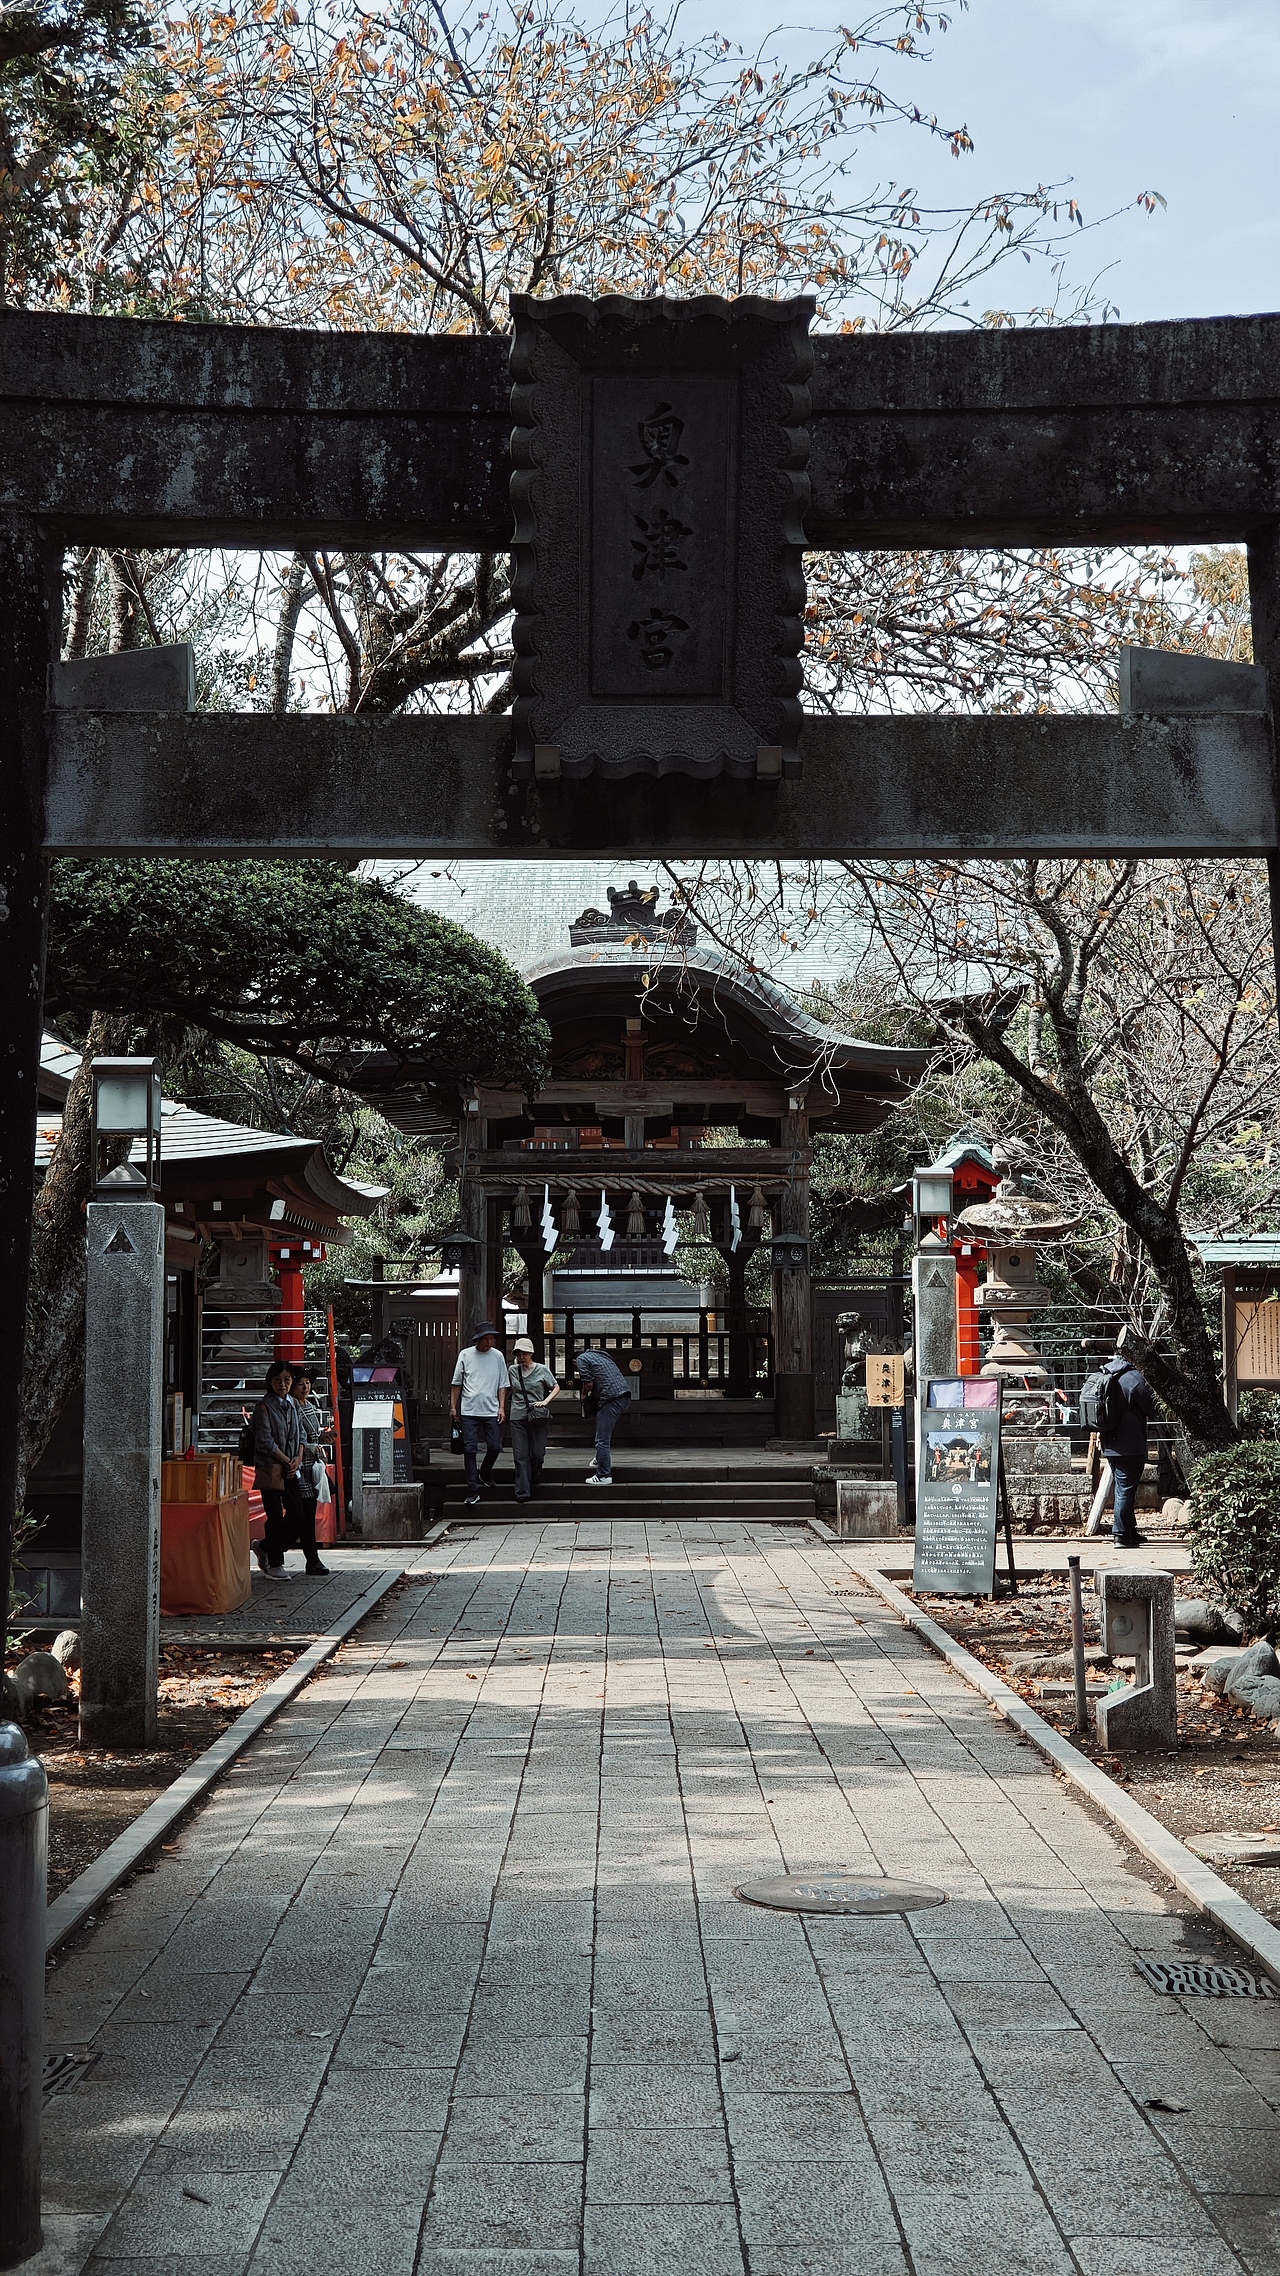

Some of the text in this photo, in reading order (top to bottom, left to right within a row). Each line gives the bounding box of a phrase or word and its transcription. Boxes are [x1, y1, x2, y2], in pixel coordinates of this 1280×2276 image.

[881, 1362, 891, 1404] 奥津宮
[941, 1417, 980, 1430] 奥津宮
